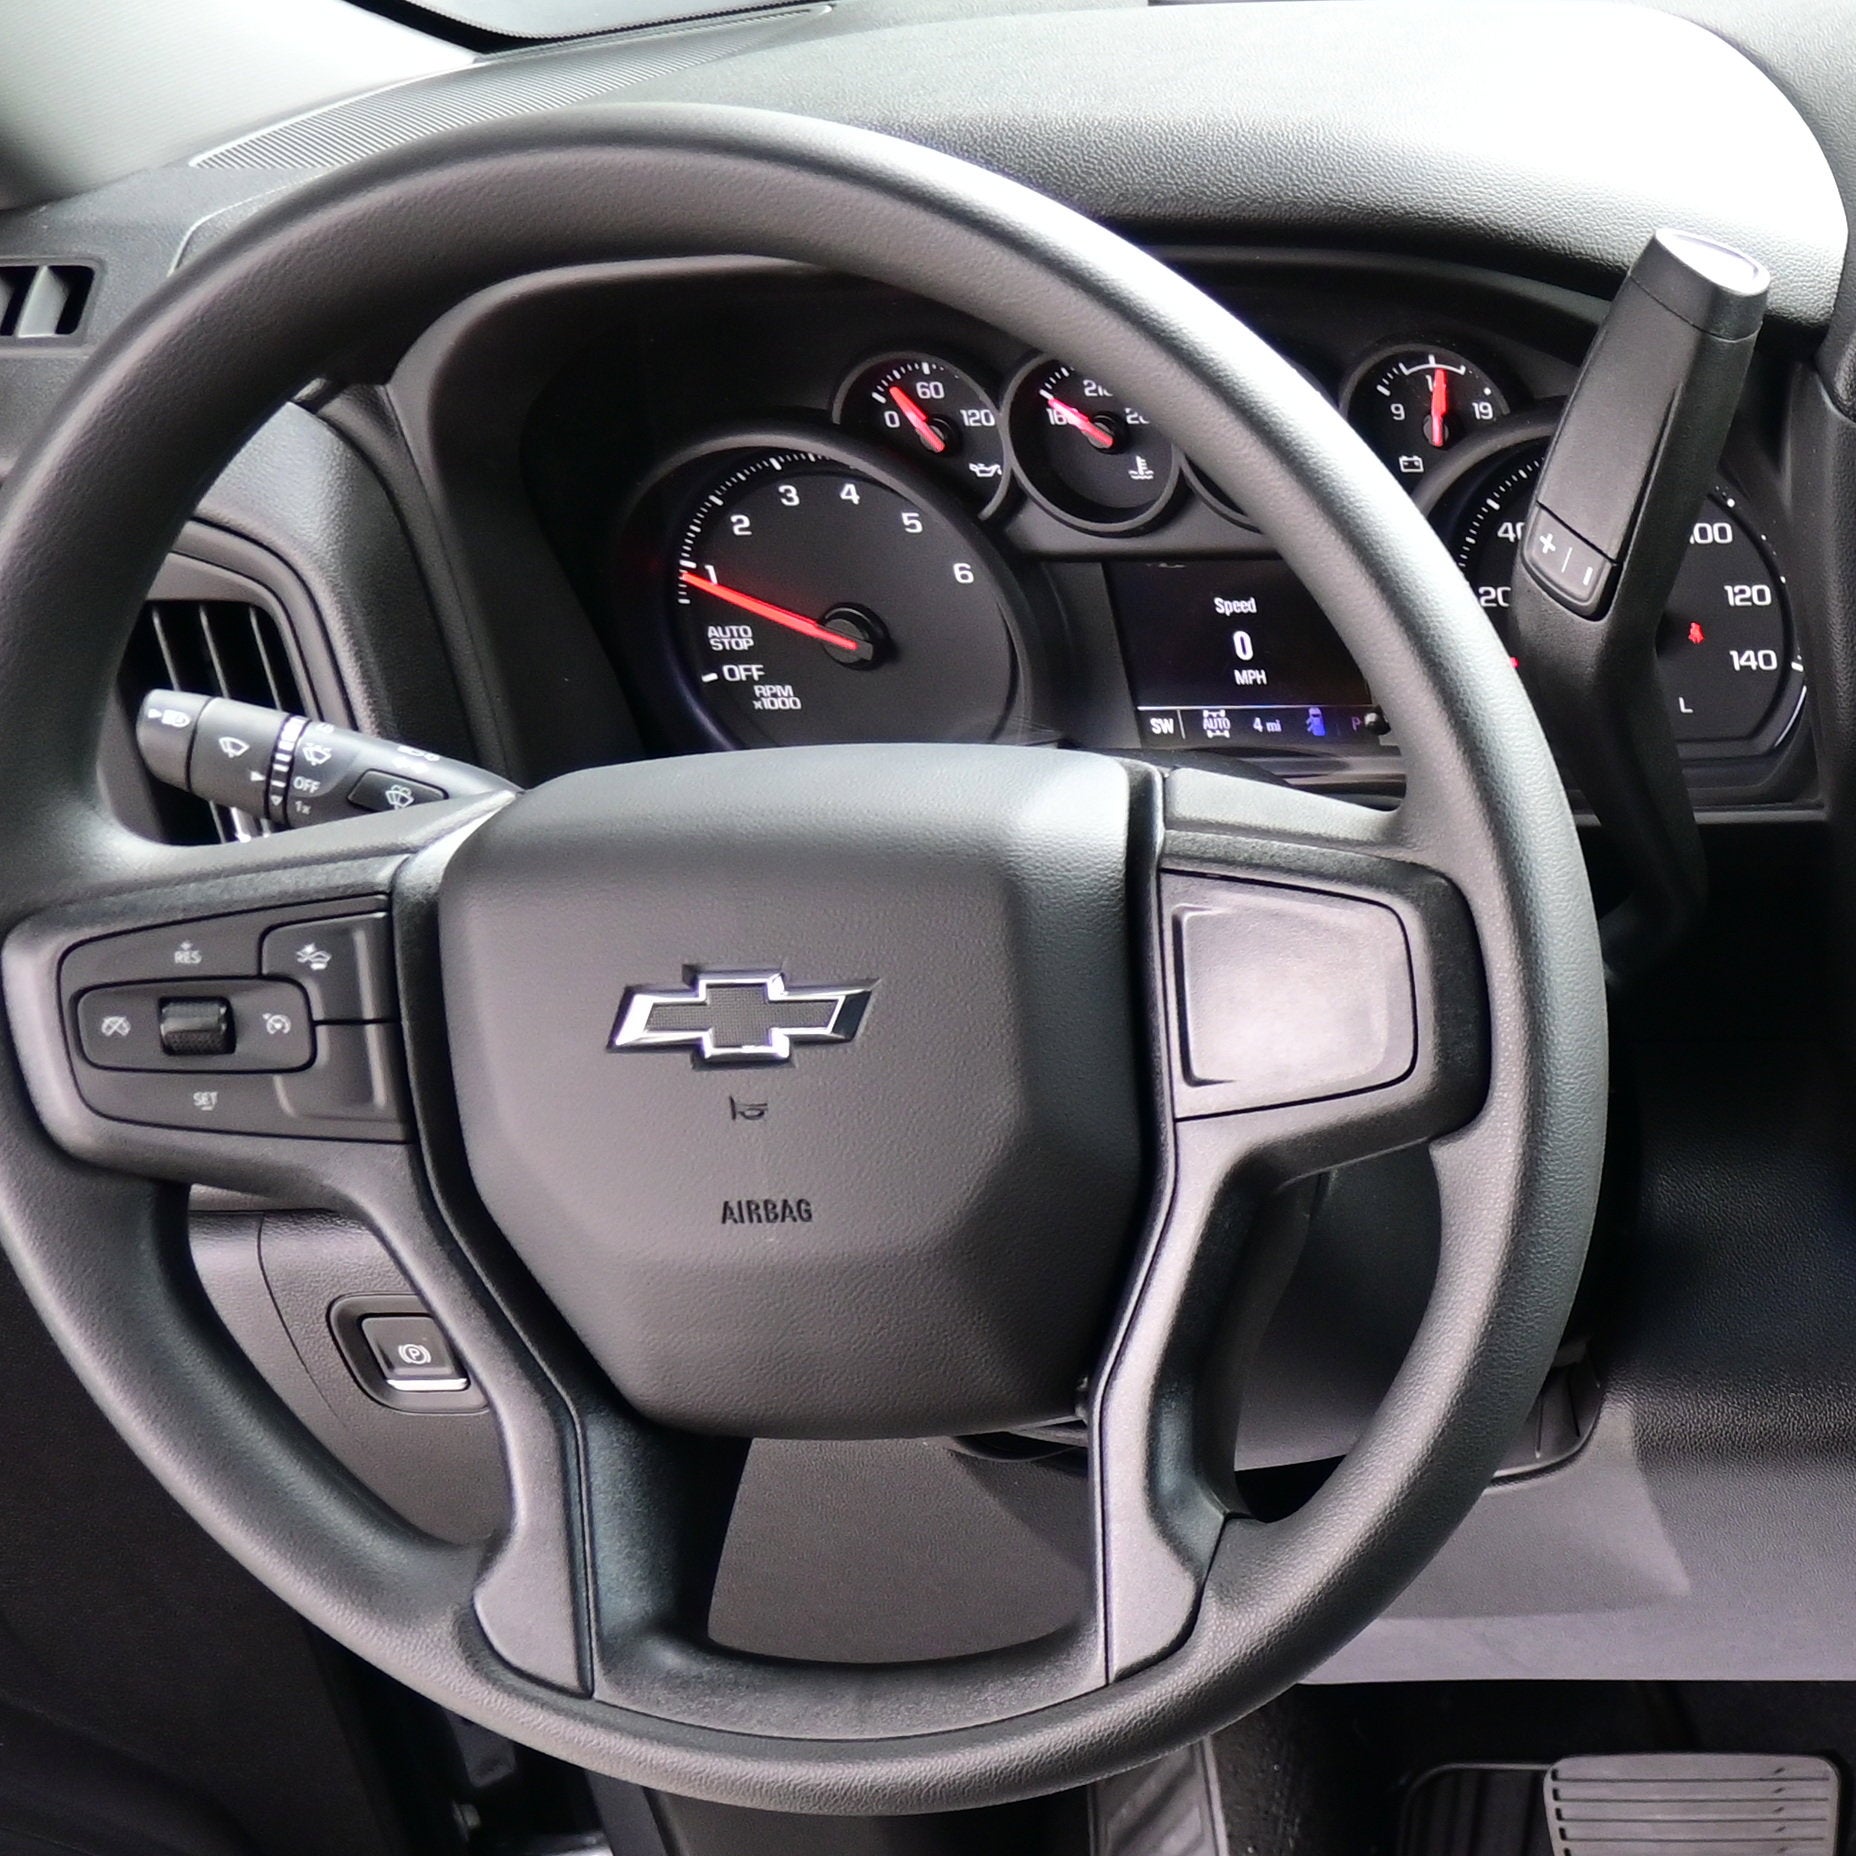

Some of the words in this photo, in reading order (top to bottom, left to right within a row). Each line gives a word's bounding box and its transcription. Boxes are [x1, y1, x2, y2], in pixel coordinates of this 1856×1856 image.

[916, 382, 944, 398] 60
[885, 411, 900, 427] 0
[961, 409, 995, 426] 120
[1391, 404, 1405, 420] 9
[1473, 402, 1493, 419] 19
[779, 485, 799, 505] 3
[841, 484, 859, 504] 4
[731, 515, 751, 535] 2
[902, 513, 922, 532] 5
[953, 563, 973, 583] 6
[1725, 585, 1771, 605] 120
[1214, 598, 1256, 616] Speed
[707, 625, 752, 640] AUTO
[708, 635, 754, 650] STOP
[1233, 631, 1253, 660] 0
[1730, 650, 1777, 670] 140
[723, 665, 764, 681] OFF
[1235, 670, 1266, 684] MPH
[753, 684, 794, 699] RPM
[754, 694, 801, 709] x1000
[1150, 718, 1174, 734] SW
[1202, 717, 1231, 731] AUTO
[1253, 718, 1263, 732] 4
[1265, 719, 1282, 733] mi
[293, 776, 320, 793] OFF
[174, 950, 201, 964] RES
[193, 1091, 217, 1107] SET
[721, 1199, 812, 1224] AIRBAG
